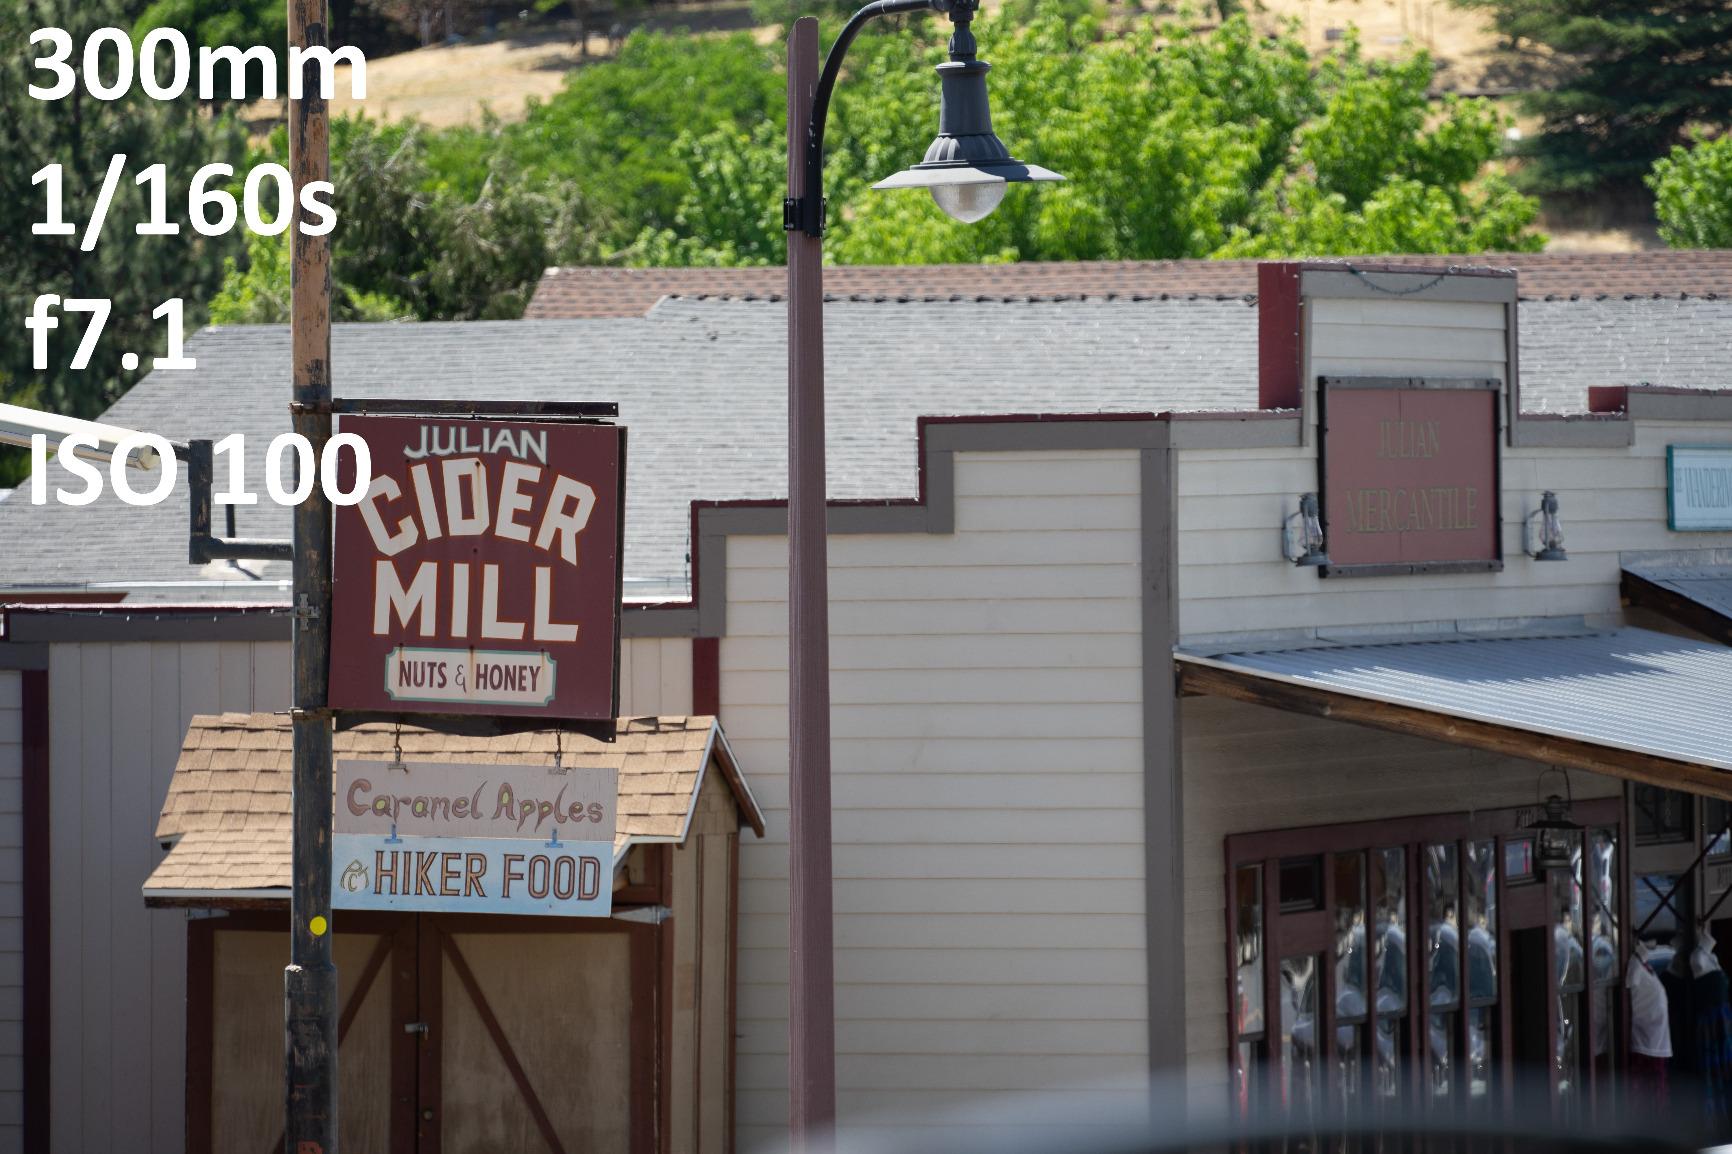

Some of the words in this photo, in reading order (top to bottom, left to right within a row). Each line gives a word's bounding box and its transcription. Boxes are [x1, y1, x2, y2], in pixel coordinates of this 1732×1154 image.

[403, 425, 547, 464] JULIAN
[1376, 419, 1441, 459] JULIAN
[357, 457, 596, 566] CIDER
[1346, 487, 1478, 533] MERCANTILE
[373, 559, 579, 642] MILL
[399, 660, 447, 688] NUTS
[455, 664, 467, 693] &
[475, 663, 541, 692] HONEY
[346, 778, 488, 825] Caramel
[491, 782, 604, 833] Apples
[373, 850, 488, 898] HIKER
[501, 853, 601, 901] FOOD
